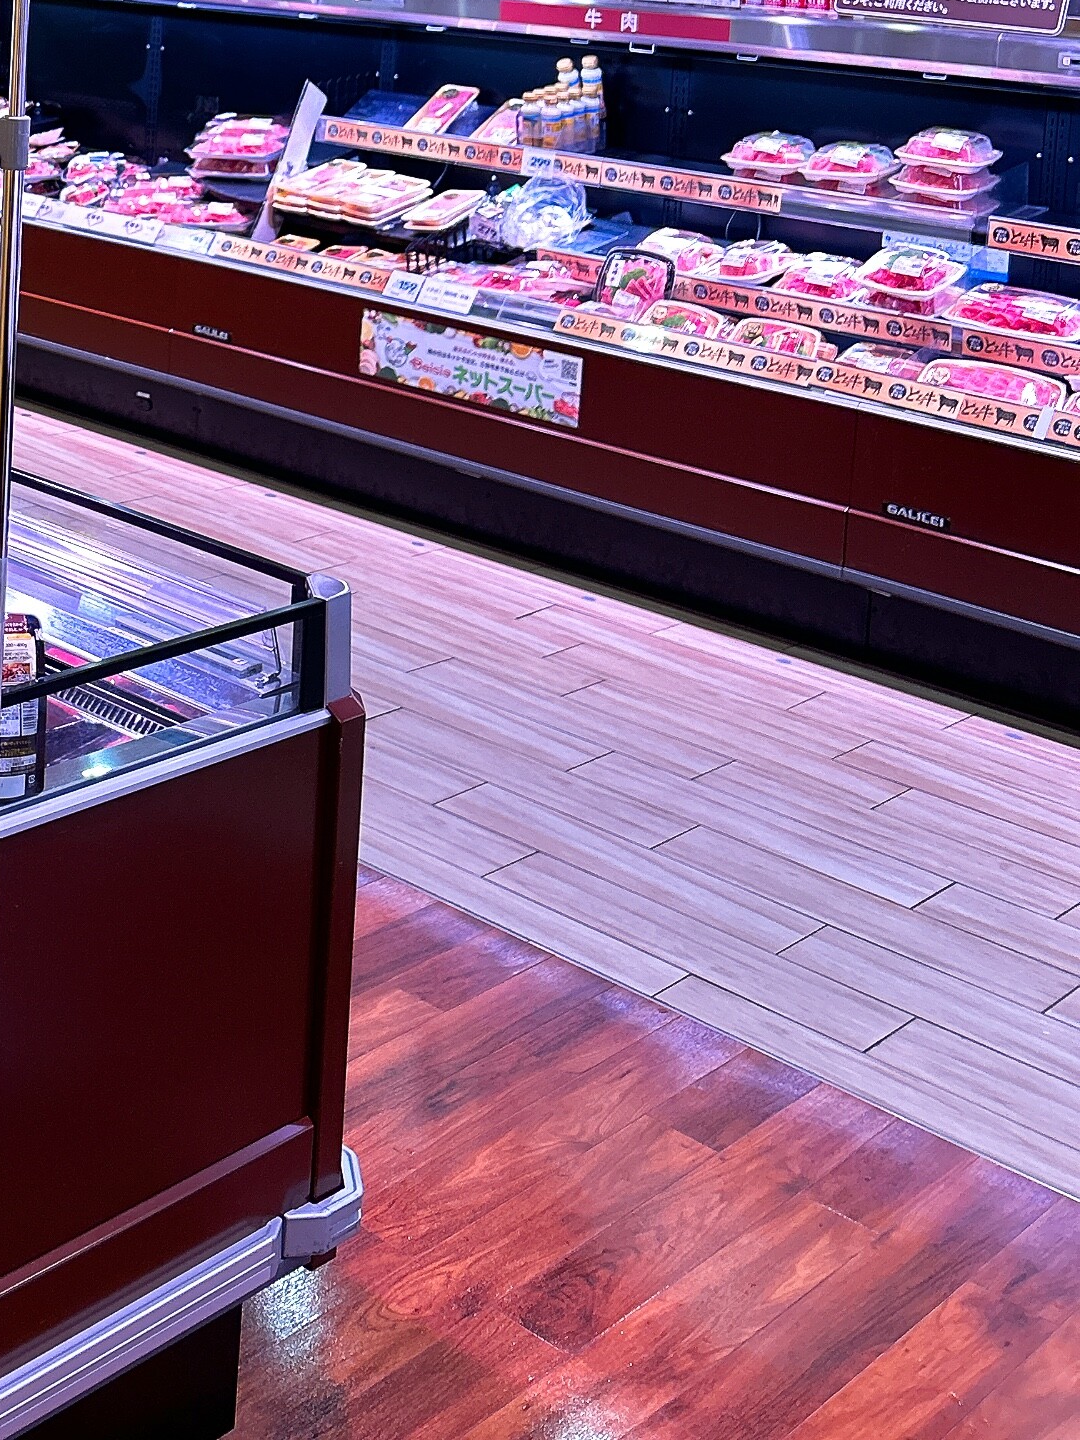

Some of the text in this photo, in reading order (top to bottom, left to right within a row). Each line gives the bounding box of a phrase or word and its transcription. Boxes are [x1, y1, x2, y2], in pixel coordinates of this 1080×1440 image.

[452, 365, 556, 404] ネットスーパー
[886, 503, 945, 528] GALILEI
